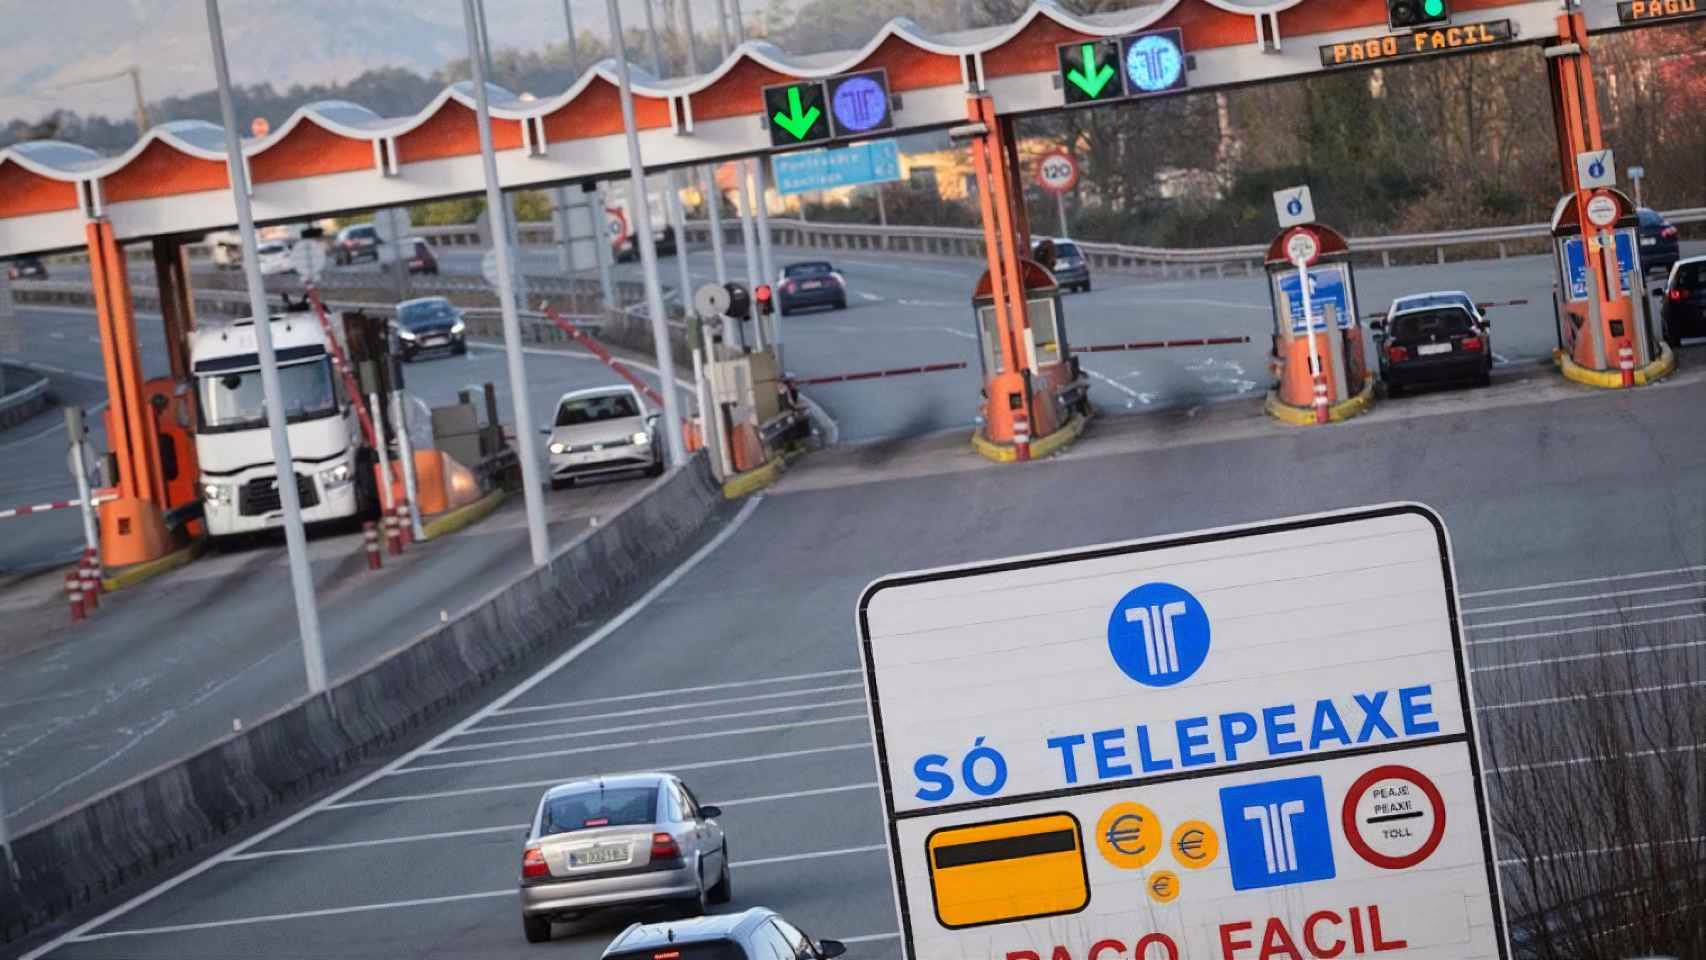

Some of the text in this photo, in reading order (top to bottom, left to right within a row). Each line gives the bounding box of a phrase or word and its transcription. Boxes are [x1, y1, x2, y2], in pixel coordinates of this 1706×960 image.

[1333, 23, 1495, 64] PAGO FACIL
[1043, 162, 1072, 179] 120
[913, 684, 1440, 802] SÓ TELEPEAXE
[1372, 784, 1410, 799] PEAJE
[1373, 800, 1413, 815] PEAXE
[1382, 827, 1413, 840] TOLL
[1218, 904, 1408, 960] FACIL
